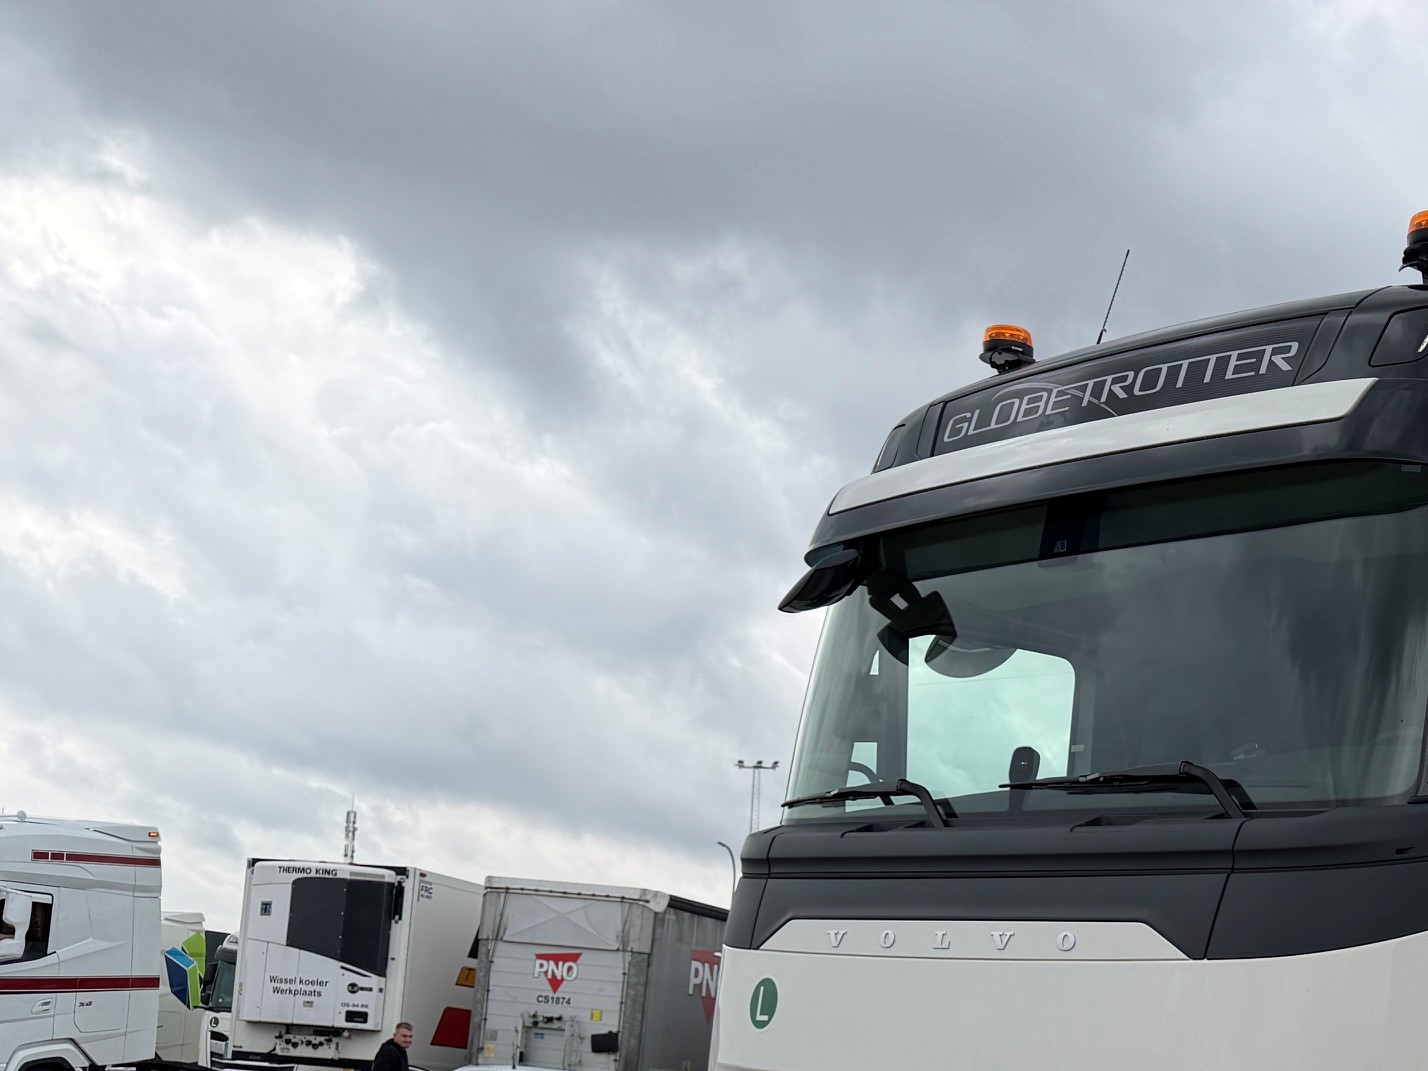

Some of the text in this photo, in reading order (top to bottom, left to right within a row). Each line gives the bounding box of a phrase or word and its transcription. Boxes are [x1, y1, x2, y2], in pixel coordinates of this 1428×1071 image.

[943, 341, 1300, 443] GLOBETROTTER
[278, 866, 338, 877] THERMO KING
[826, 929, 1077, 952] VOLVO
[534, 959, 579, 981] PNO
[269, 975, 329, 987] Wissel koeler
[688, 960, 717, 998] PN
[272, 986, 322, 998] Werkplaats
[536, 994, 571, 1006] CS1874
